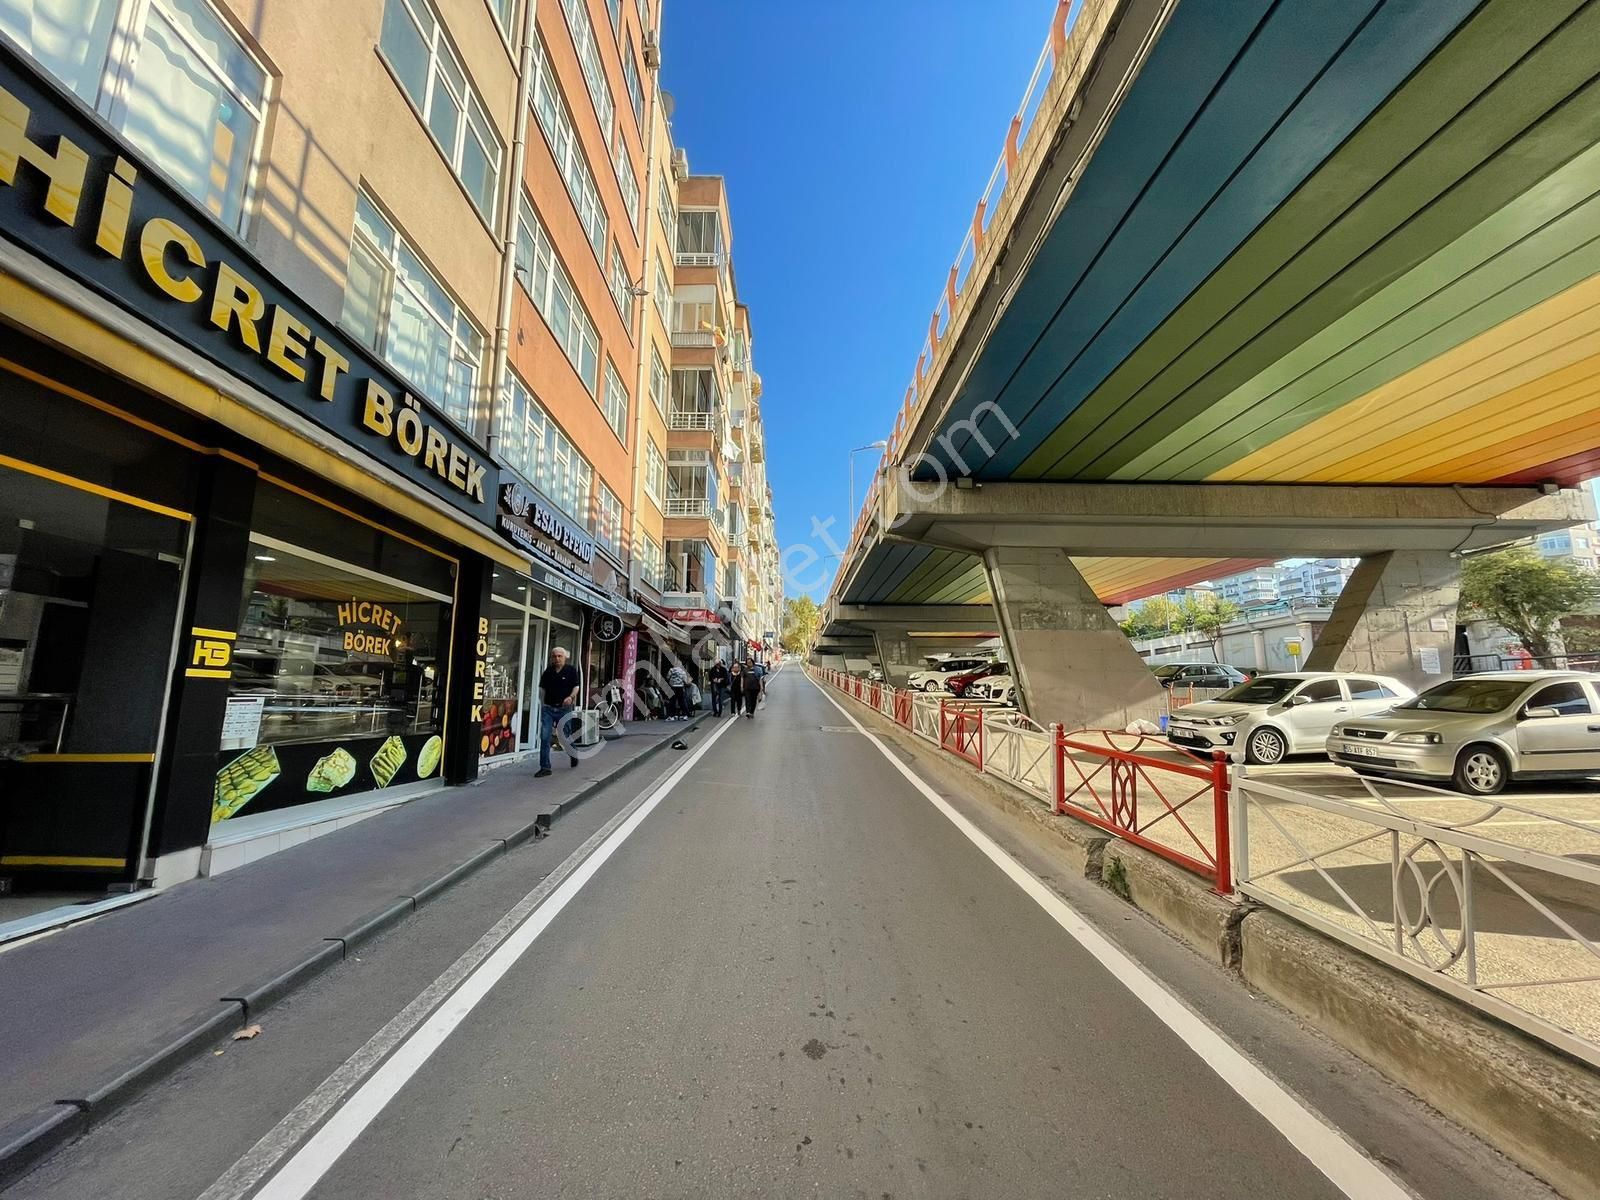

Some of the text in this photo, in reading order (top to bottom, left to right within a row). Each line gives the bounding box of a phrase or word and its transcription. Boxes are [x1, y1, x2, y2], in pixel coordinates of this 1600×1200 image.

[0, 85, 488, 504] HİCRET BÖREK
[533, 503, 562, 541] ESAD
[337, 596, 402, 635] HİCRET
[343, 629, 391, 656] BÖREK
[470, 616, 489, 722] BÖREK
